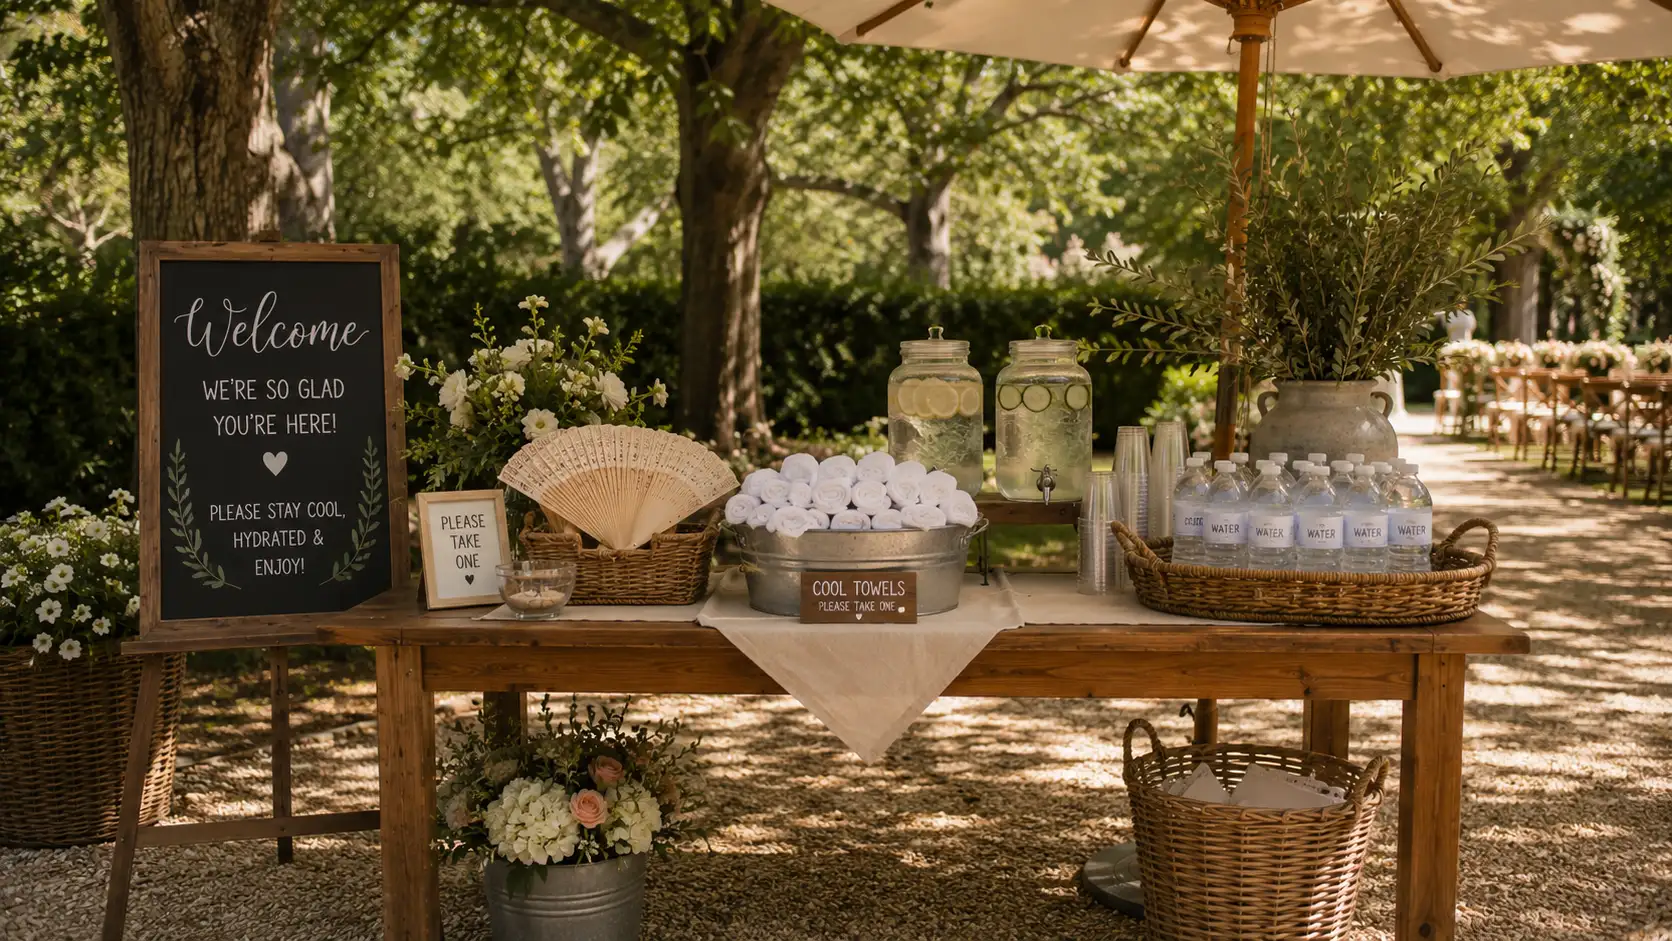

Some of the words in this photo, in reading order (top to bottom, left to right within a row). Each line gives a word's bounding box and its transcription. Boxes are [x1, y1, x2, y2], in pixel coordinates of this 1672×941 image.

[174, 291, 370, 357] Welcome
[203, 378, 257, 400] WE'RE
[266, 379, 289, 400] SO
[298, 378, 345, 400] GLAD
[213, 414, 277, 436] YOU'RE
[286, 413, 337, 434] HERE!
[210, 503, 261, 521] PLEASE
[268, 502, 301, 519] STAY
[307, 501, 346, 519] COOL,
[441, 513, 486, 530] PLEASE
[1211, 523, 1240, 534] WATER
[233, 529, 306, 548] HYDRATED
[312, 528, 324, 546] &
[1255, 527, 1284, 538] WATER
[1307, 528, 1336, 539] WATER
[1353, 527, 1382, 538] WATER
[1397, 525, 1426, 536] WATER
[450, 533, 482, 550] TAKE
[255, 558, 305, 576] ENJOY!
[456, 553, 481, 570] ONE
[812, 580, 847, 596] COOL
[853, 580, 906, 596] TOWELS
[818, 600, 850, 612] PLEASE
[853, 600, 875, 612] TAKE
[879, 600, 896, 612] ONE
